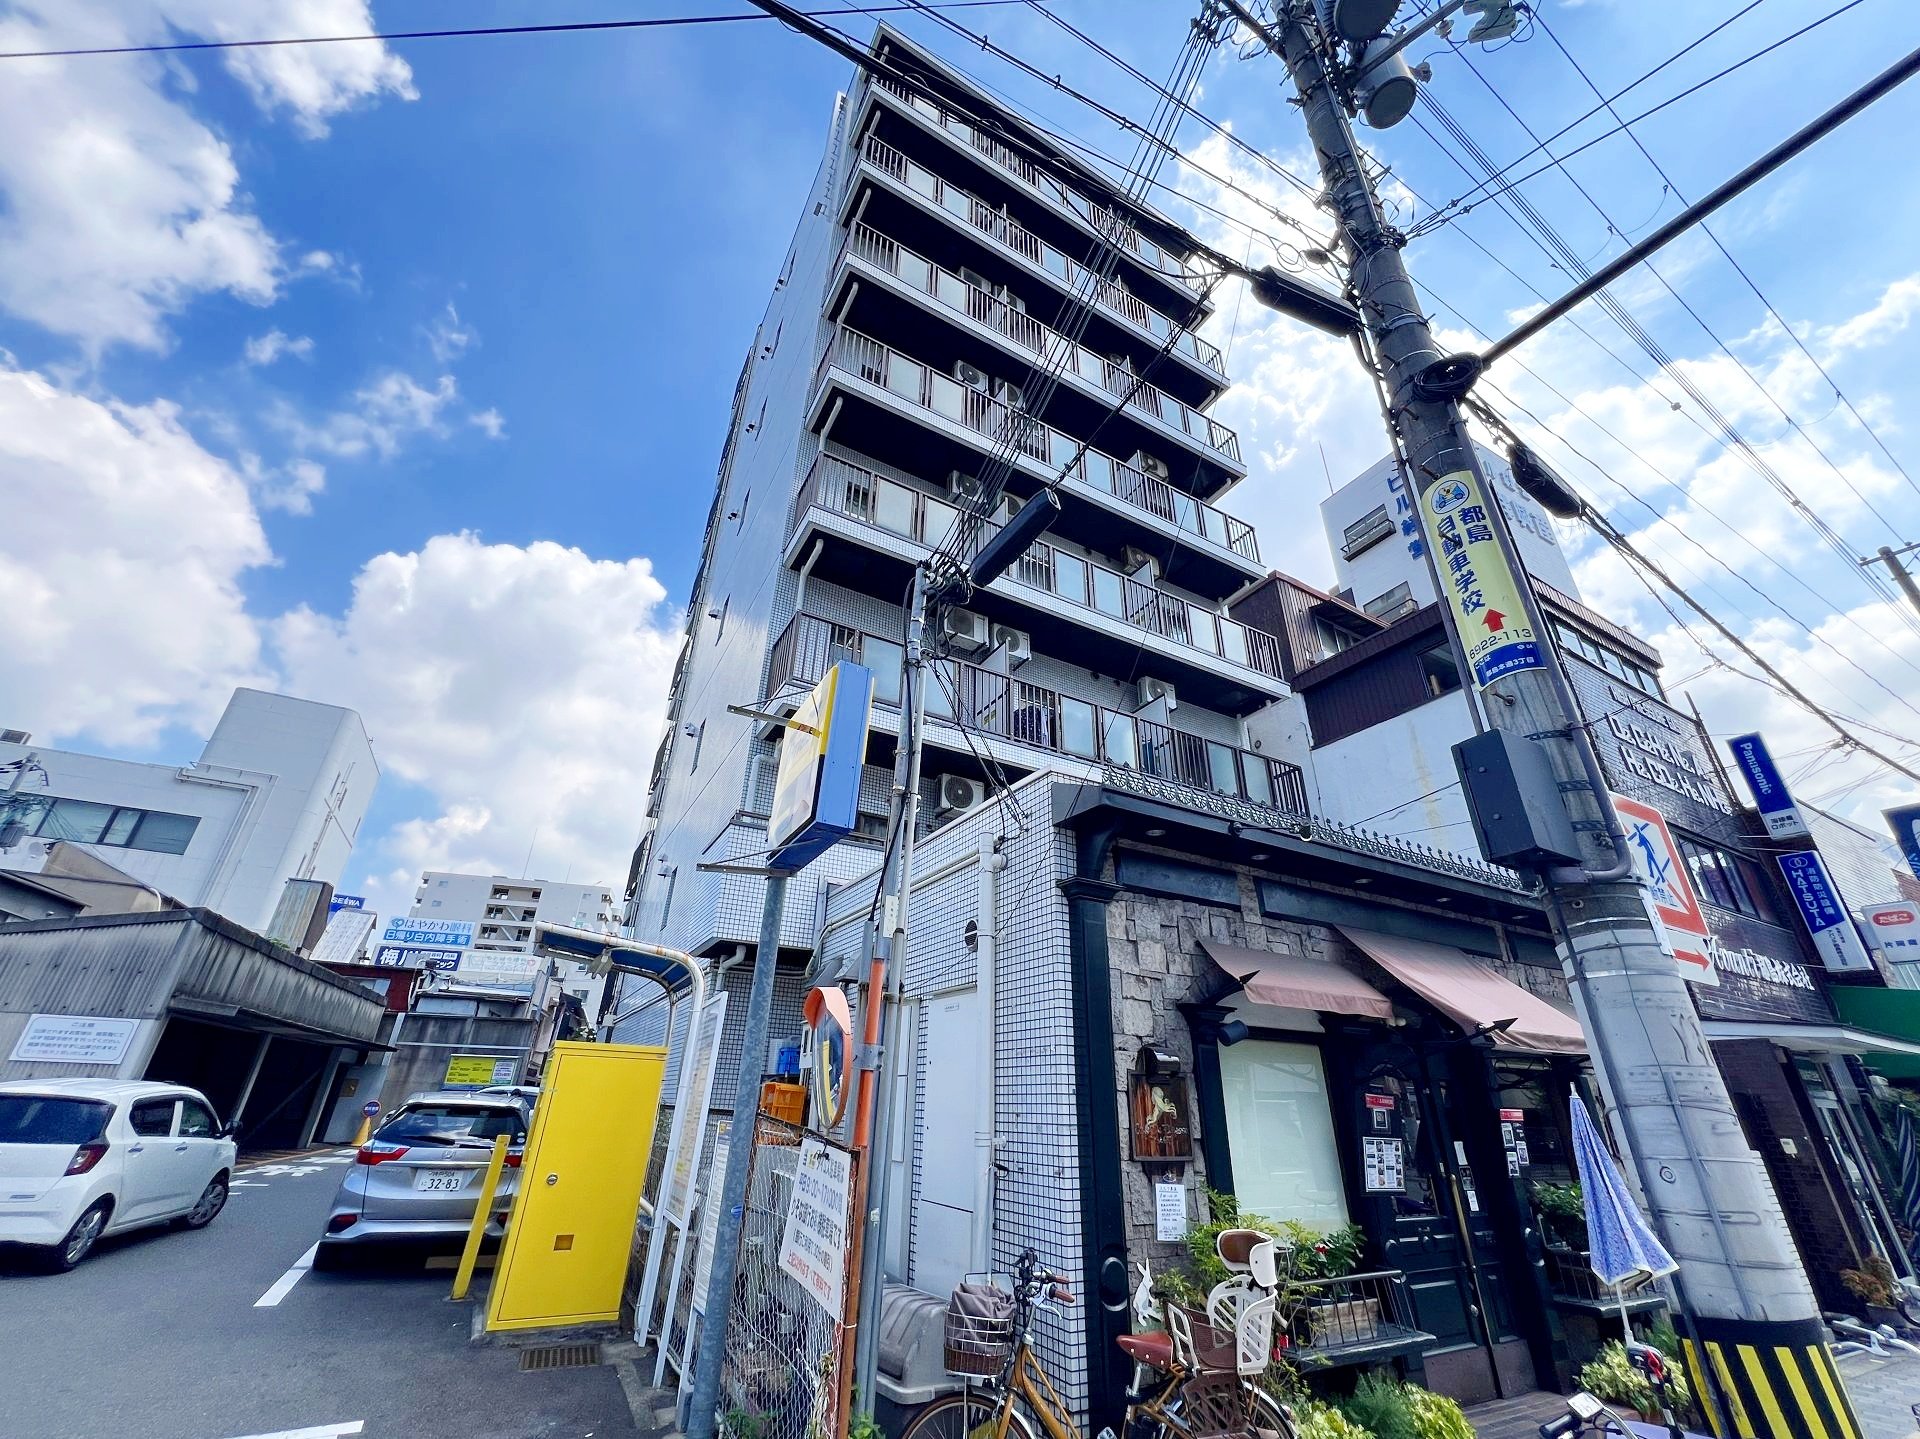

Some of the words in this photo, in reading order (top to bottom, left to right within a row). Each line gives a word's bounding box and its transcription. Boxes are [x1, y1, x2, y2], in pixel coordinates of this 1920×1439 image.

[1458, 505, 1494, 545] 都島
[1437, 515, 1487, 616] 自動車学校
[1740, 742, 1772, 795] Panasonic
[1771, 820, 1799, 831] ロボット
[1791, 869, 1826, 927] HATSUTA
[385, 929, 468, 945] 日帰り白内障手術
[404, 919, 472, 934] はやかわ眼科
[427, 1178, 460, 1190] 32-83
